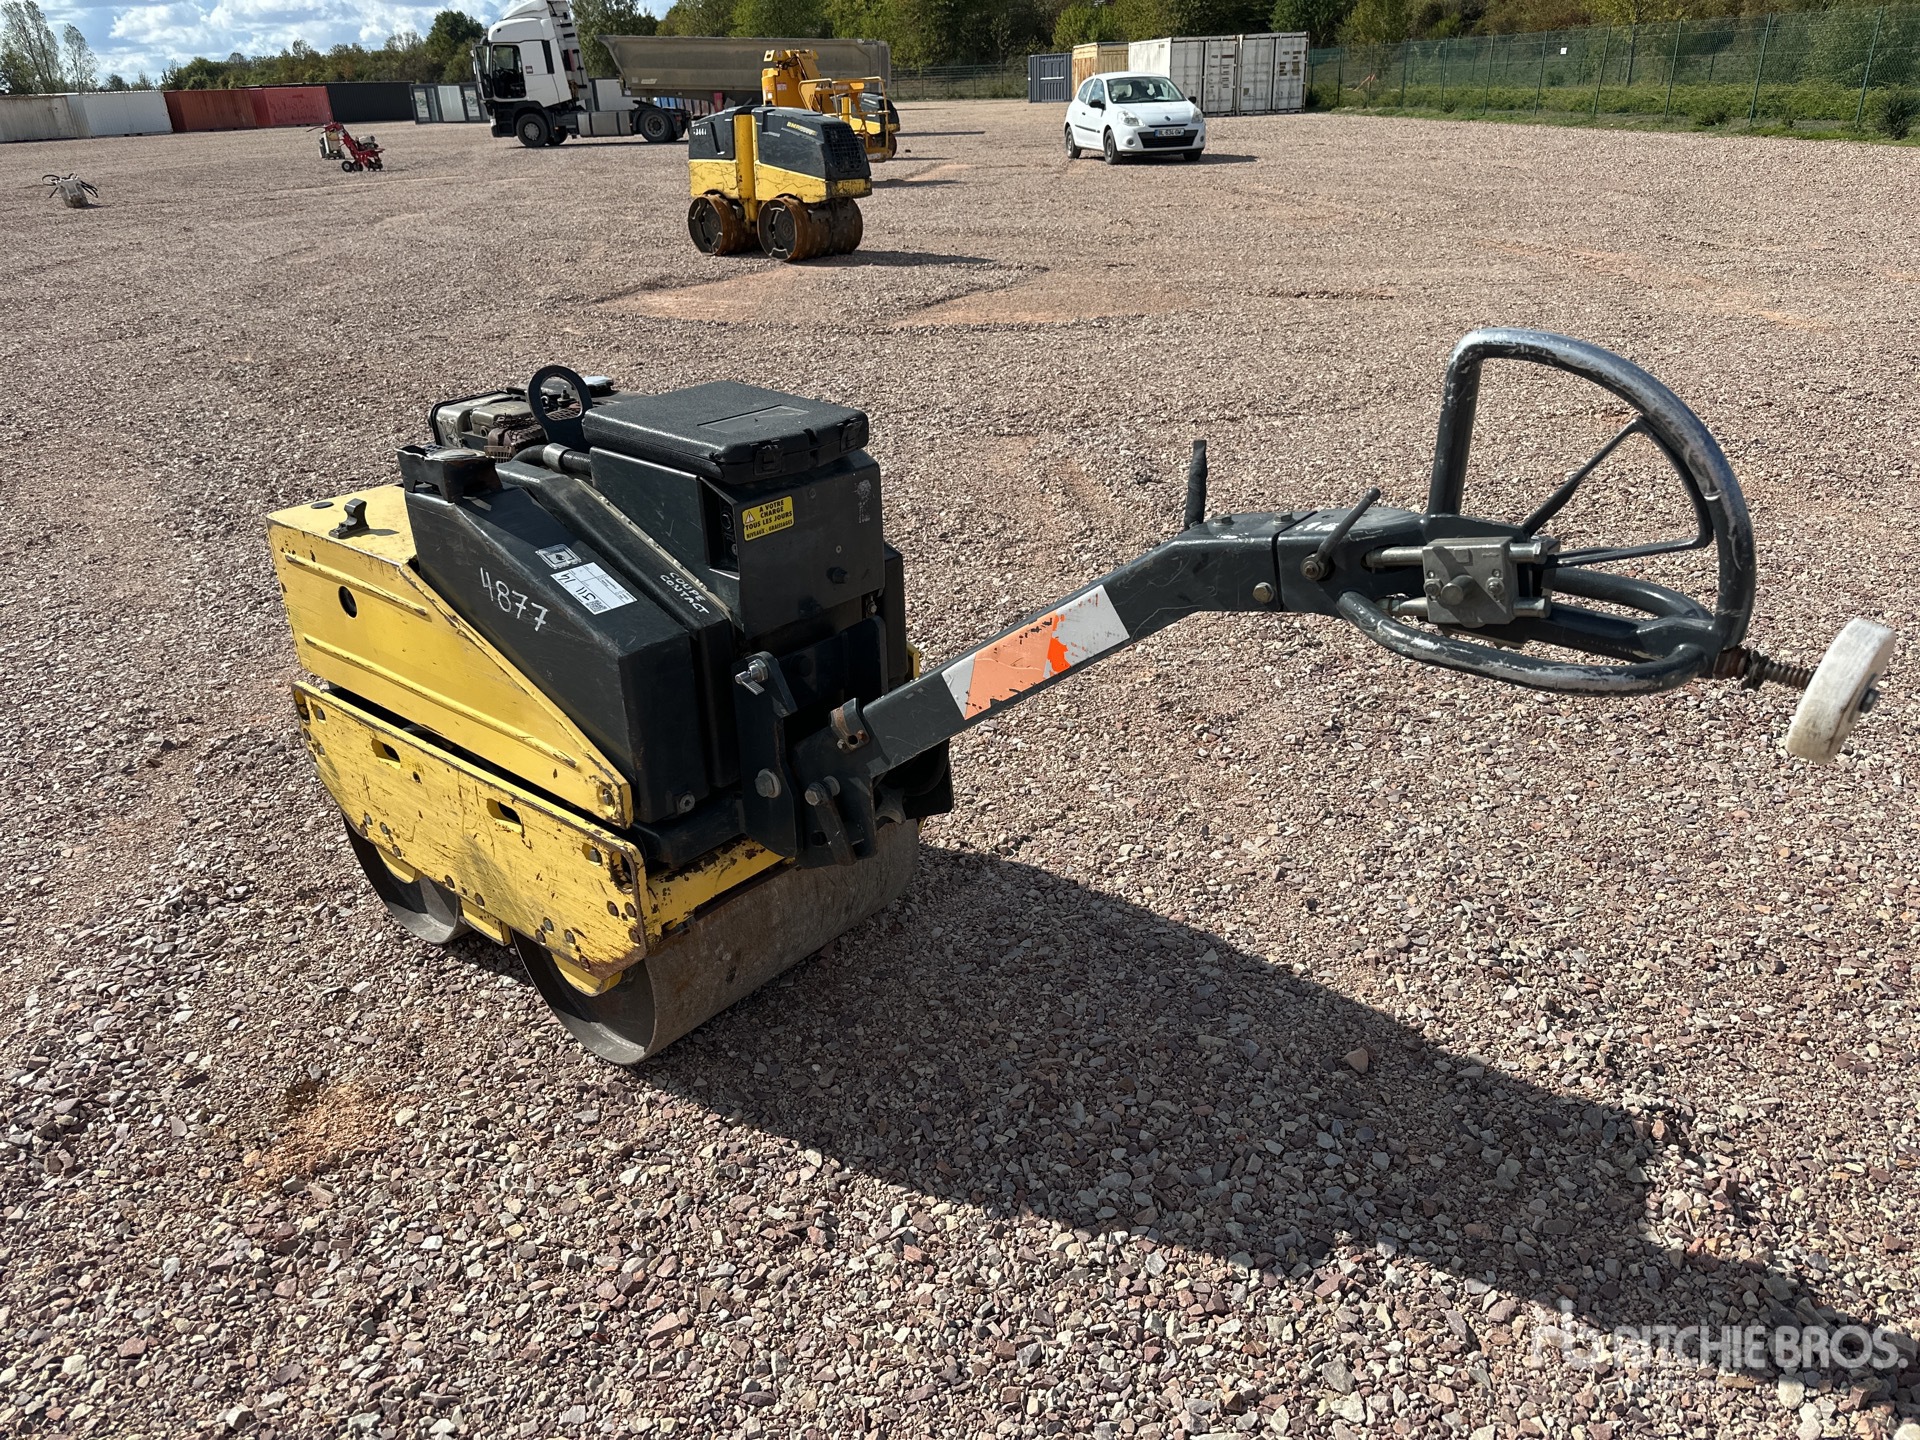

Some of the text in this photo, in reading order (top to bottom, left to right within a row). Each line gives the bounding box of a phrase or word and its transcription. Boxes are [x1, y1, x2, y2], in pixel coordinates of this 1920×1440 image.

[760, 506, 784, 518] CHARGE
[765, 500, 784, 510] VOTRE
[745, 511, 792, 530] TOUS LES JOURS
[746, 528, 765, 539] NIVEAUX
[768, 519, 793, 531] GRAISSAGES
[660, 575, 710, 613] CONTACT
[670, 572, 706, 601] COUPE
[480, 567, 548, 631] 4877
